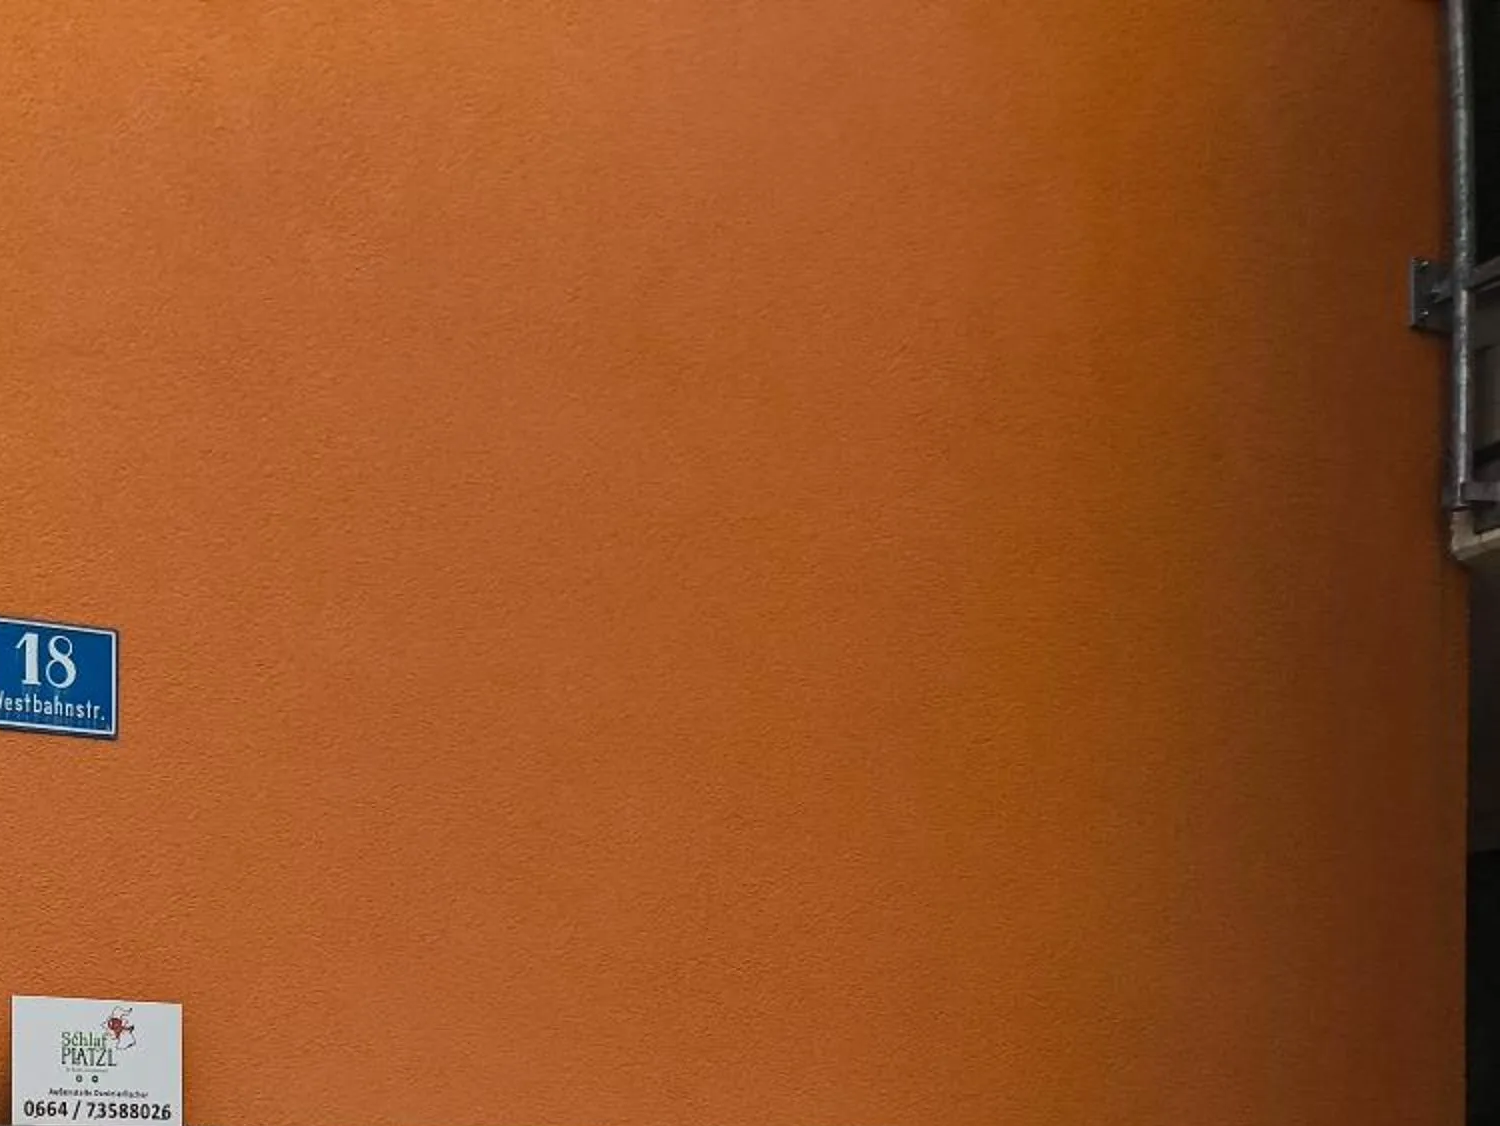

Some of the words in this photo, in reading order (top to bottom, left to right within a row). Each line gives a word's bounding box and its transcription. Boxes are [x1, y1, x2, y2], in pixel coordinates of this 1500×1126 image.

[15, 632, 77, 689] 18
[61, 1031, 107, 1048] Schlaf
[23, 1100, 68, 1119] 0664
[71, 1100, 82, 1121] /
[86, 1102, 172, 1121] 73588026
